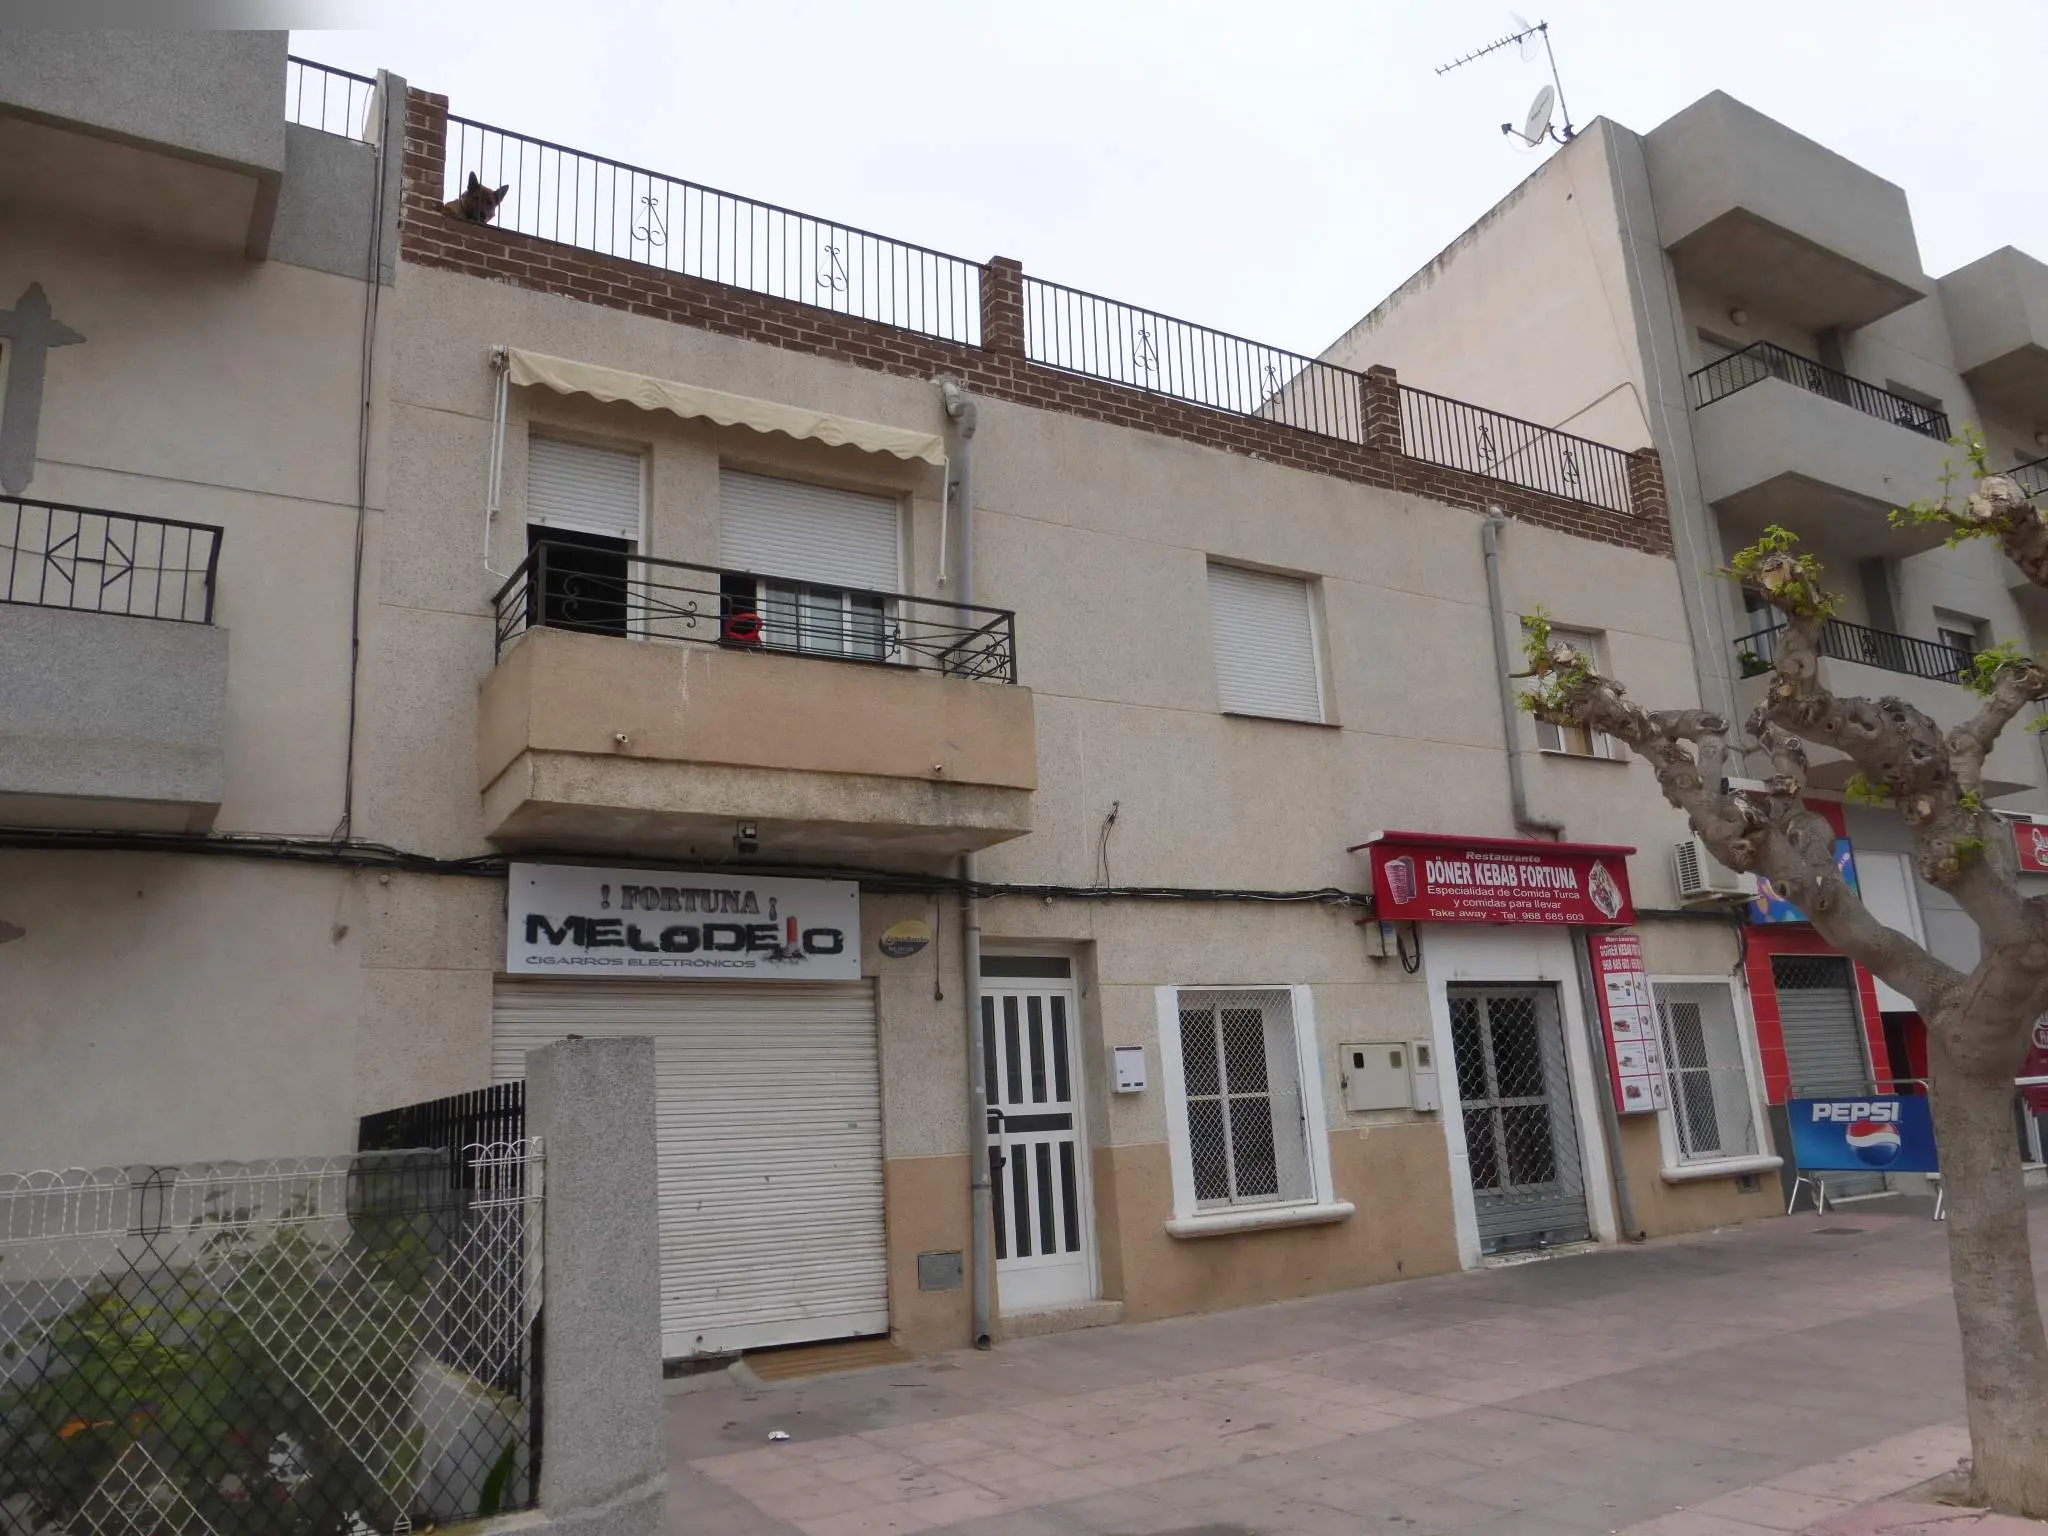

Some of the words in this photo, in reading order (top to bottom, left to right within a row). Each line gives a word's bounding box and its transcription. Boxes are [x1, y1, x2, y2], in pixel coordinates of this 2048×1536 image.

[1466, 851, 1541, 863] Restaurante
[1425, 856, 1473, 885] DÖNER
[1473, 862, 1518, 887] KEBAB
[1519, 865, 1578, 889] FORTUNA
[1427, 885, 1494, 896] Especialidad
[1497, 888, 1511, 897] de
[1512, 888, 1551, 898] Comida
[1553, 890, 1580, 900] Turca
[621, 885, 760, 915] FORTUNA
[1463, 899, 1507, 908] comidas
[1509, 901, 1532, 909] para
[1534, 900, 1561, 909] llevar
[1428, 909, 1455, 917] Take
[1459, 910, 1487, 919] away
[526, 956, 624, 967] CIGARROS
[628, 957, 757, 969] ELECTRÓNICOS
[1812, 1102, 1900, 1122] PEPSI
